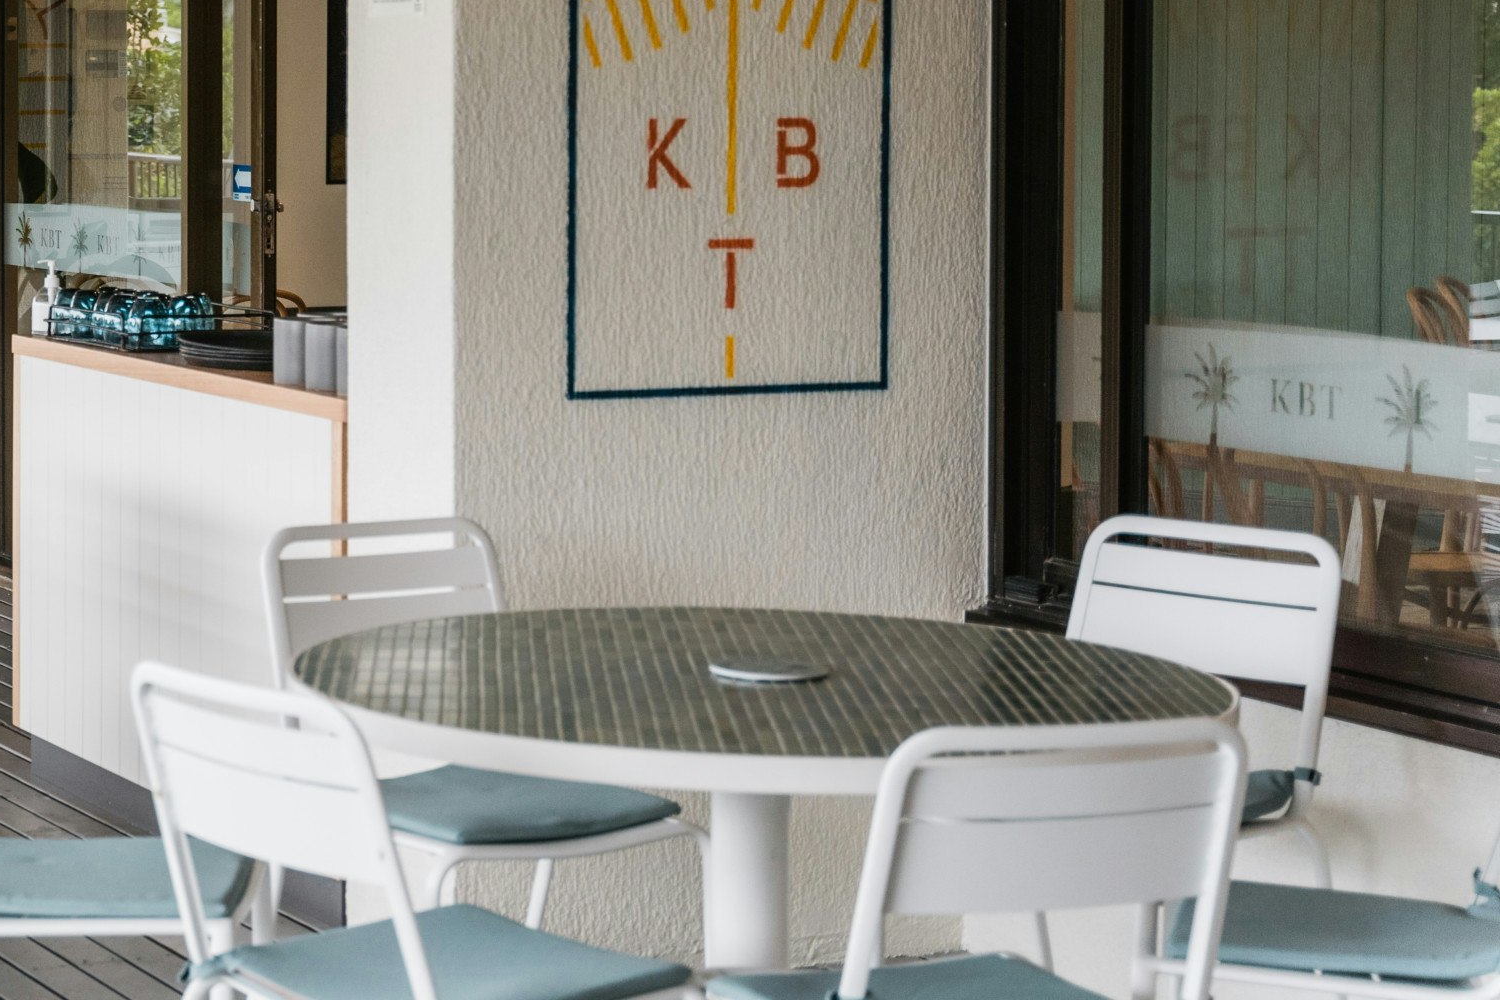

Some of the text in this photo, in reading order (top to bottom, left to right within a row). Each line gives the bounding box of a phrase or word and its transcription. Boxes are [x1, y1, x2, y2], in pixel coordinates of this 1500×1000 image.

[40, 227, 62, 249] KBT
[97, 233, 119, 256] KBT
[1269, 378, 1343, 420] KBT
